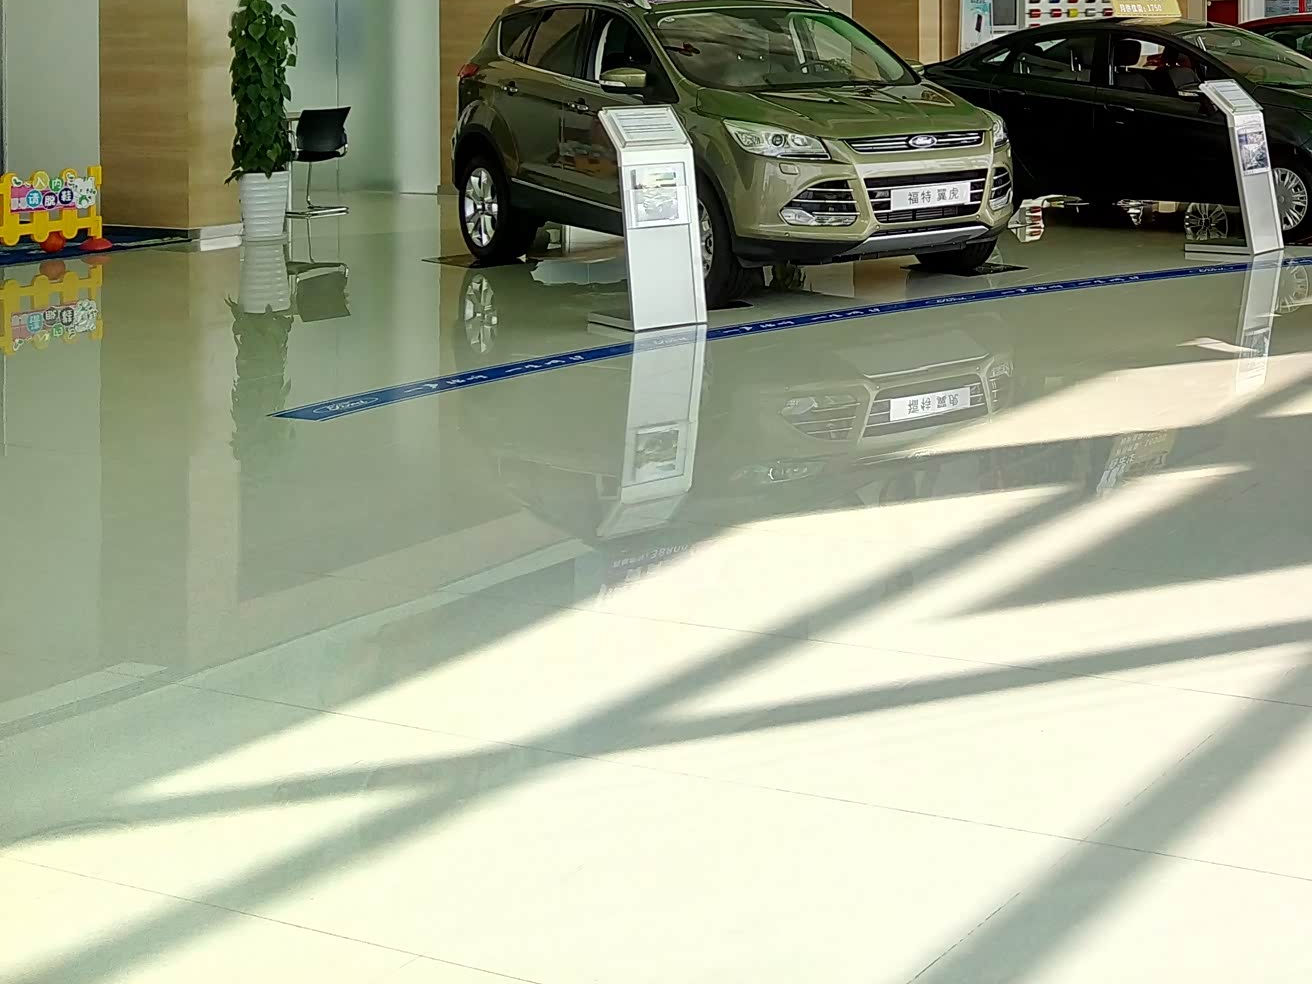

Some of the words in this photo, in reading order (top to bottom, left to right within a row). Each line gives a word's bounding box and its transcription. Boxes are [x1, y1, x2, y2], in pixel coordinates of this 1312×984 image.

[28, 189, 72, 207] 请脱鞋
[908, 190, 931, 205] 福特
[937, 187, 959, 201] 翼虎
